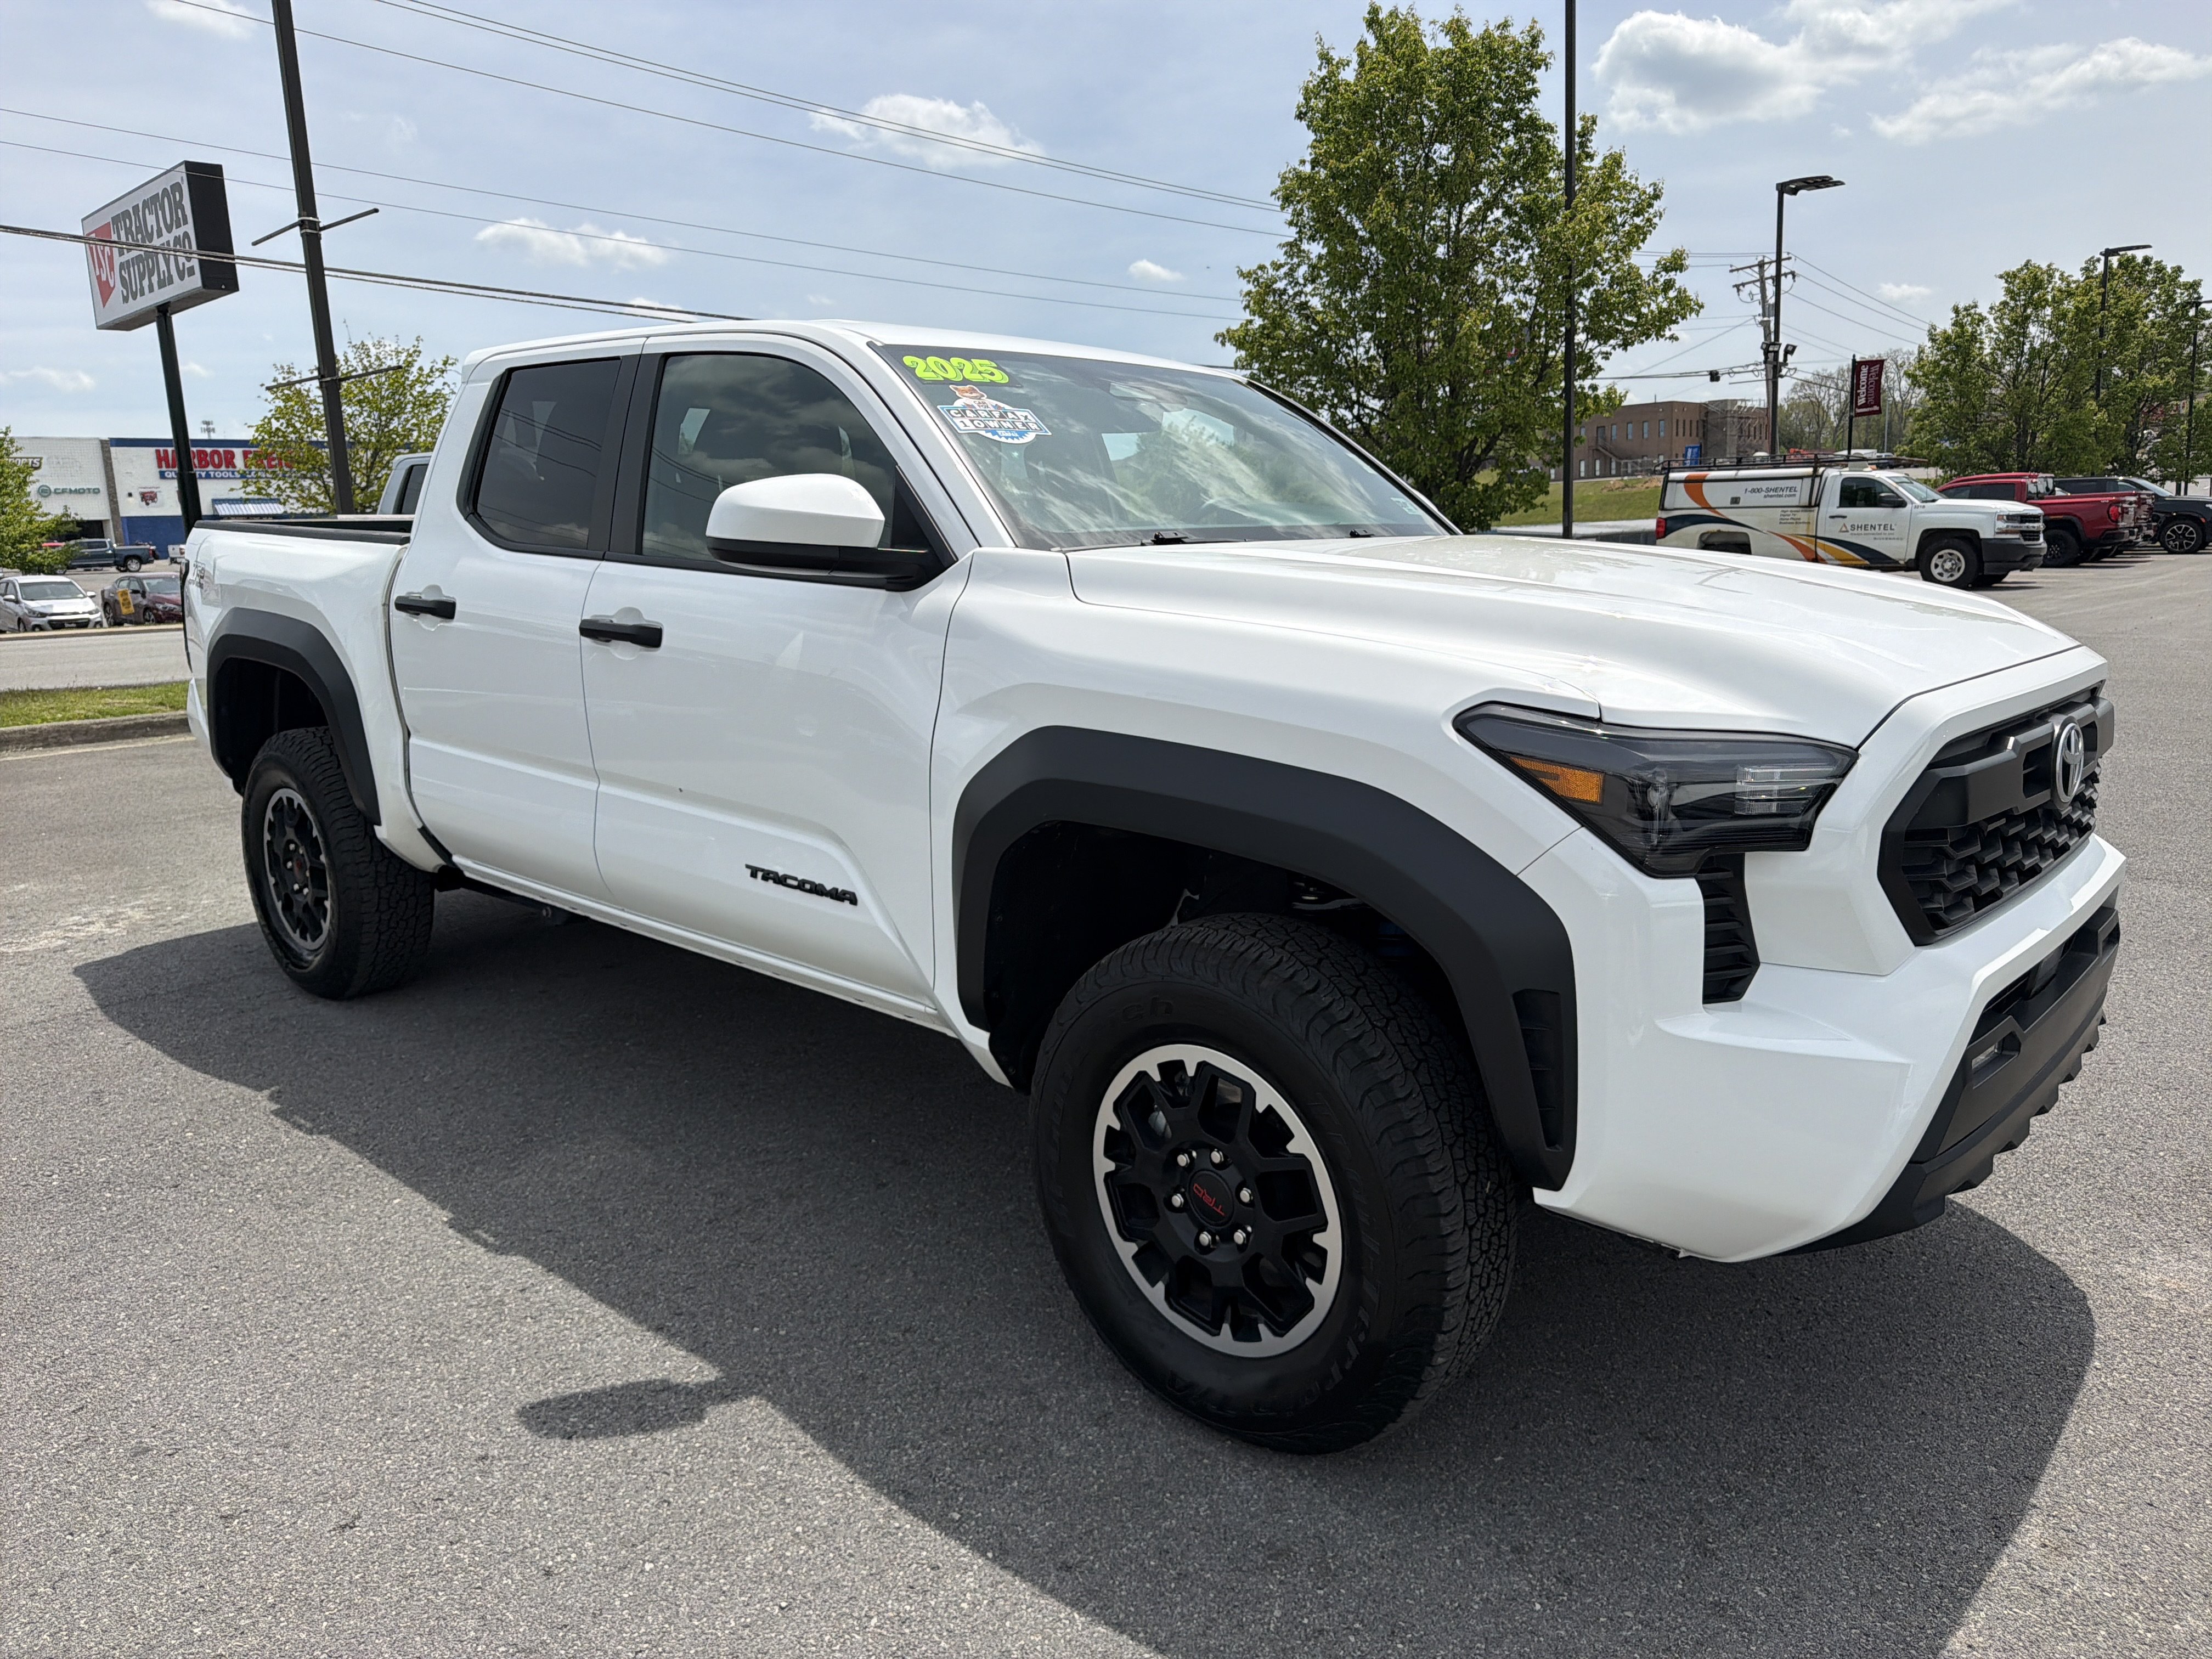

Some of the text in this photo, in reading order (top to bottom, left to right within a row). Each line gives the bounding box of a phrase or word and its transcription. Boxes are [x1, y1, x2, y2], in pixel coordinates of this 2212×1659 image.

[111, 181, 188, 257] TRACTOR
[86, 233, 115, 288] TSC
[119, 238, 174, 304] SUPPLY
[903, 356, 1009, 383] 2025
[1857, 365, 1869, 406] Welcome
[1867, 364, 1880, 404] Welcome
[949, 409, 1032, 422] CARFAX
[973, 420, 1041, 431] OWNER
[745, 864, 858, 906] TACOMA
[1193, 1183, 1227, 1217] TRD
